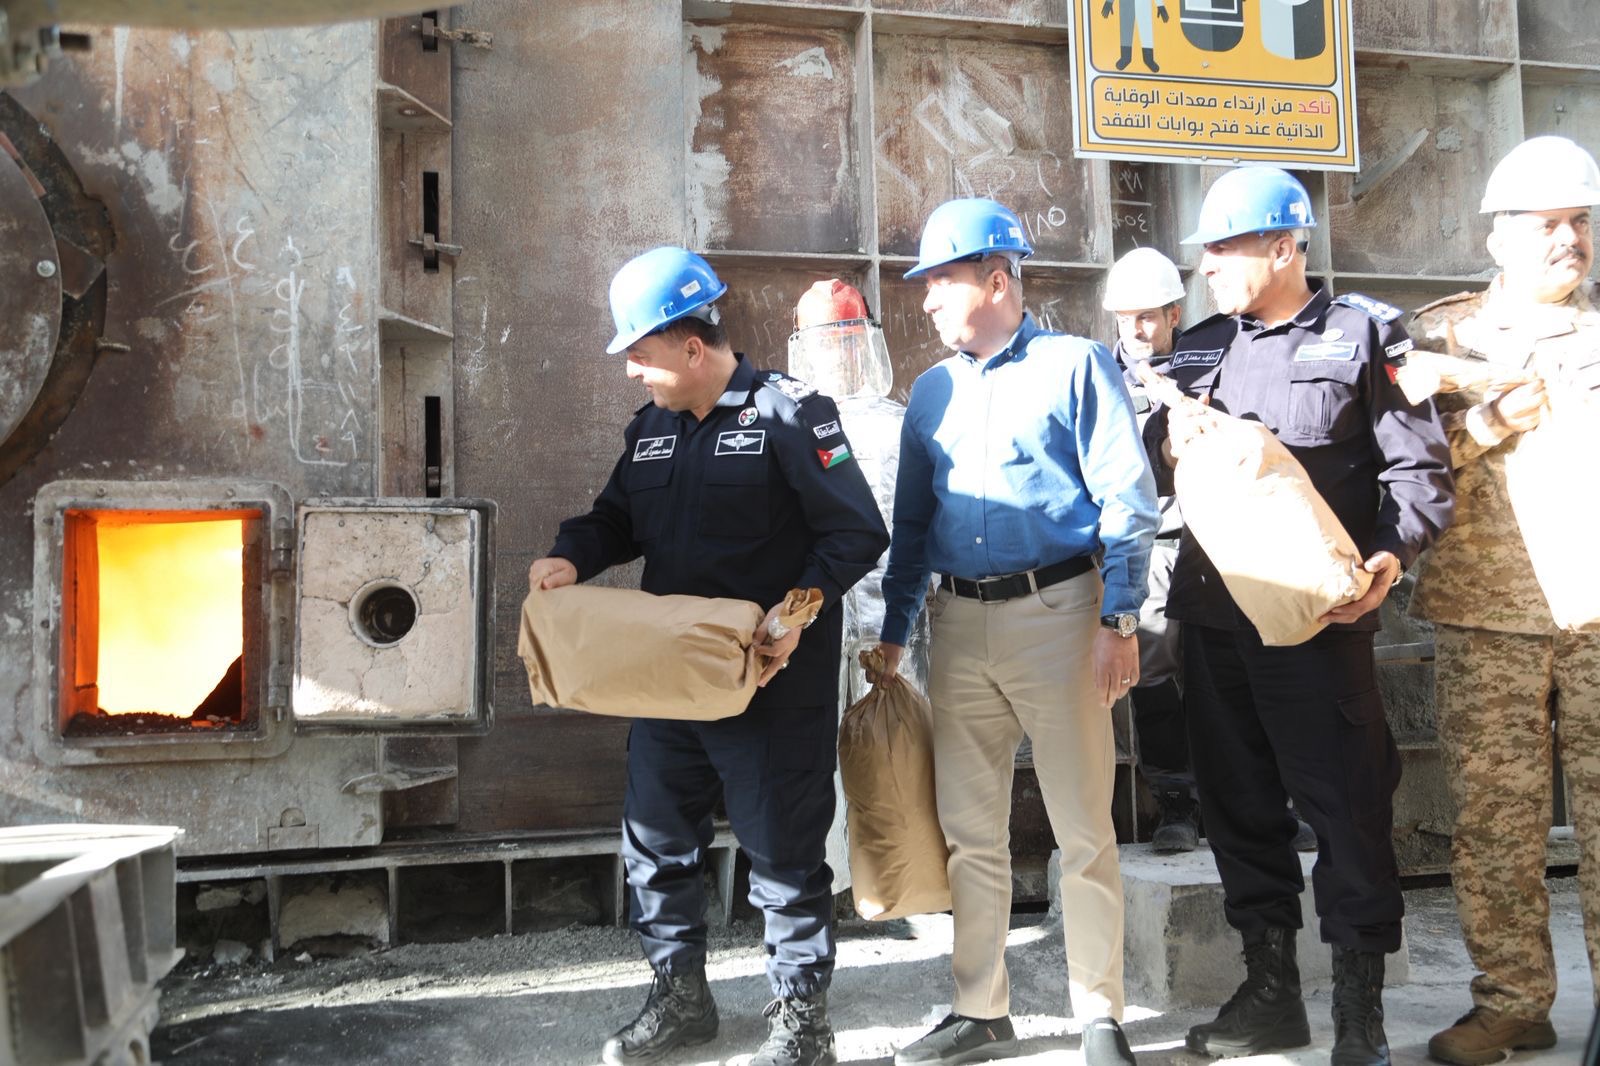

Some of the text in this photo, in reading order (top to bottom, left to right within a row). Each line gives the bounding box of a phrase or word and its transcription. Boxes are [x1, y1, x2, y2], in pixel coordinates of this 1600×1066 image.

[1104, 87, 1160, 109] الوقاية
[1166, 92, 1217, 108] معدات
[1298, 97, 1331, 114] تأكد
[1271, 99, 1293, 115] من
[1101, 112, 1323, 141] الذاتية عند فتح بوابات التفقد
